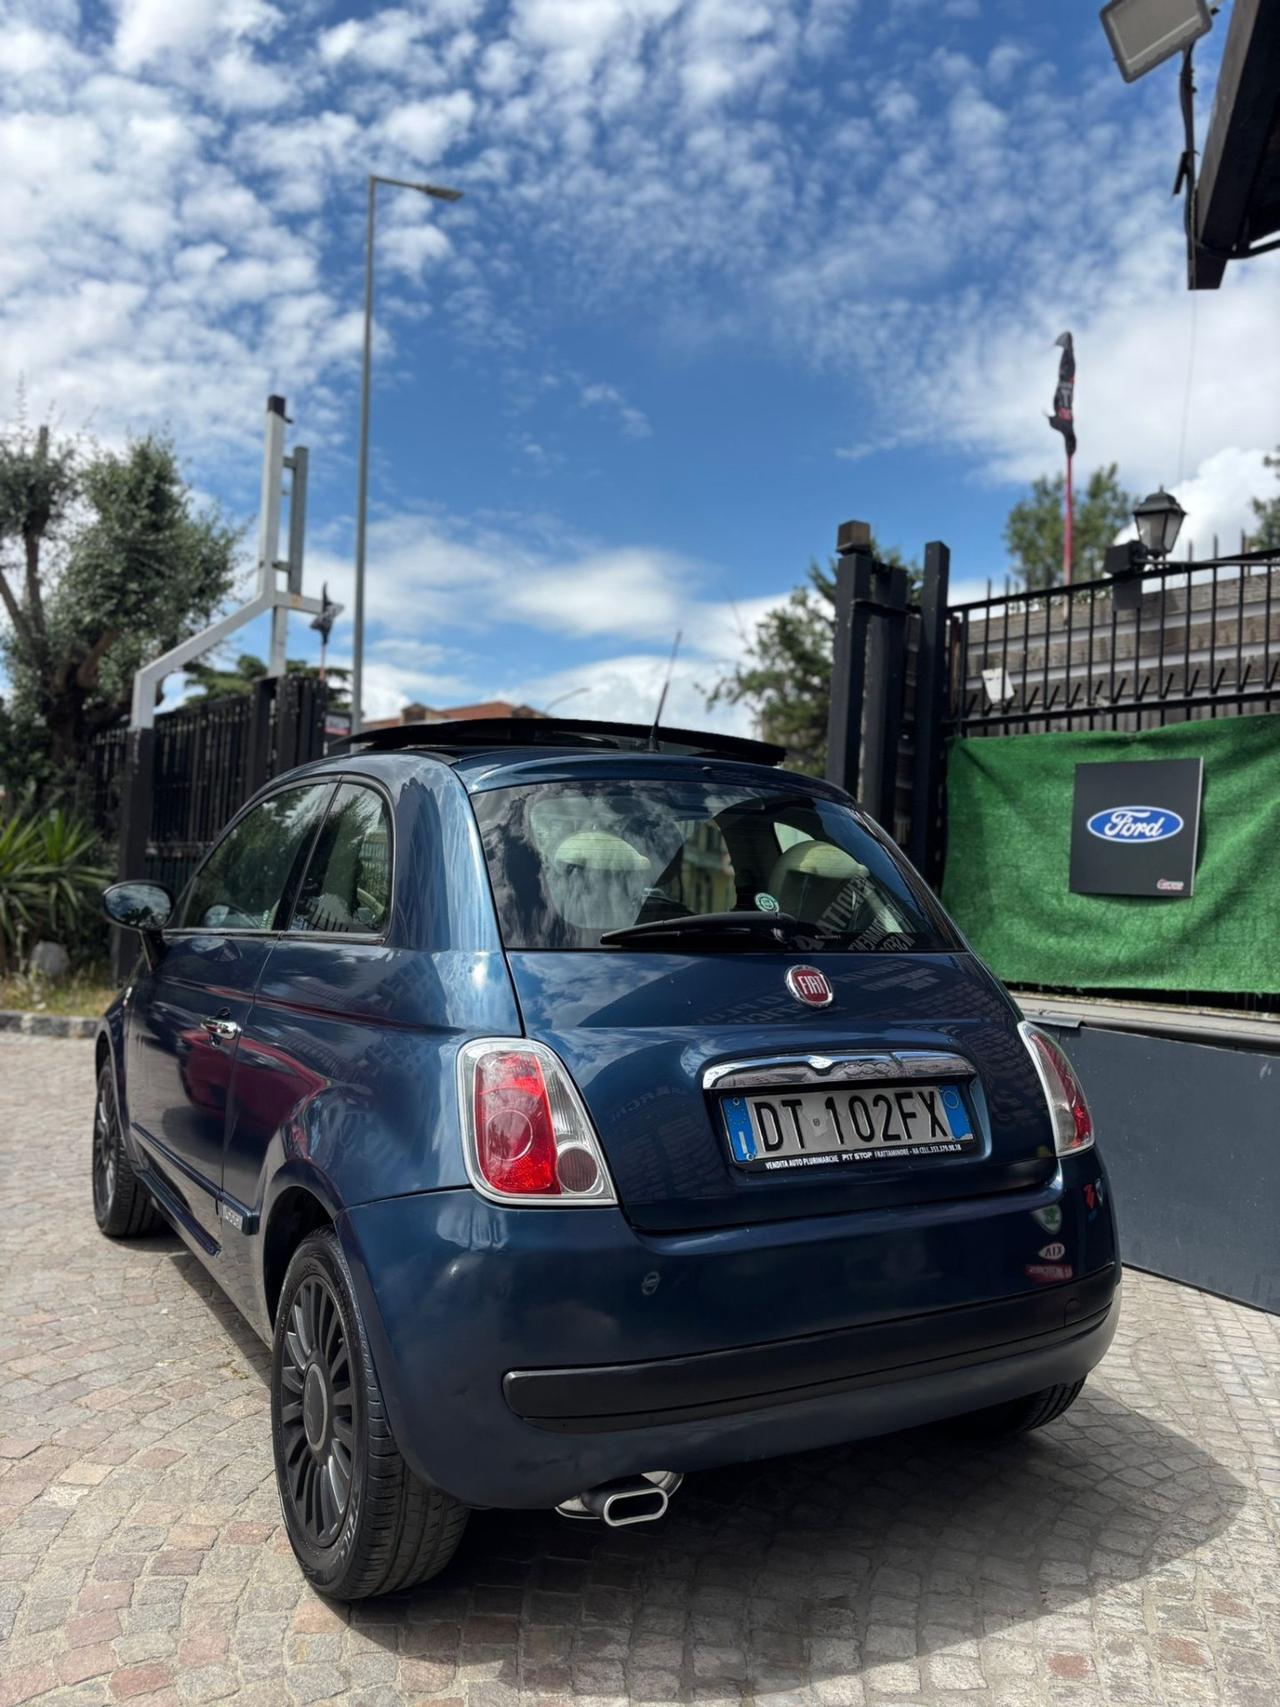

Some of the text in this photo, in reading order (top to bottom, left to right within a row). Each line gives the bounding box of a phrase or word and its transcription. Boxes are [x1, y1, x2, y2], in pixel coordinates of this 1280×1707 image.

[1104, 810, 1165, 837] Ford
[797, 975, 826, 995] FIAT
[753, 1098, 806, 1153] DT
[825, 1090, 948, 1146] 102FX
[765, 1159, 789, 1170] VENDITA
[789, 1158, 803, 1167] AUTO
[842, 1153, 853, 1161] PIT
[854, 1151, 873, 1160] STOP
